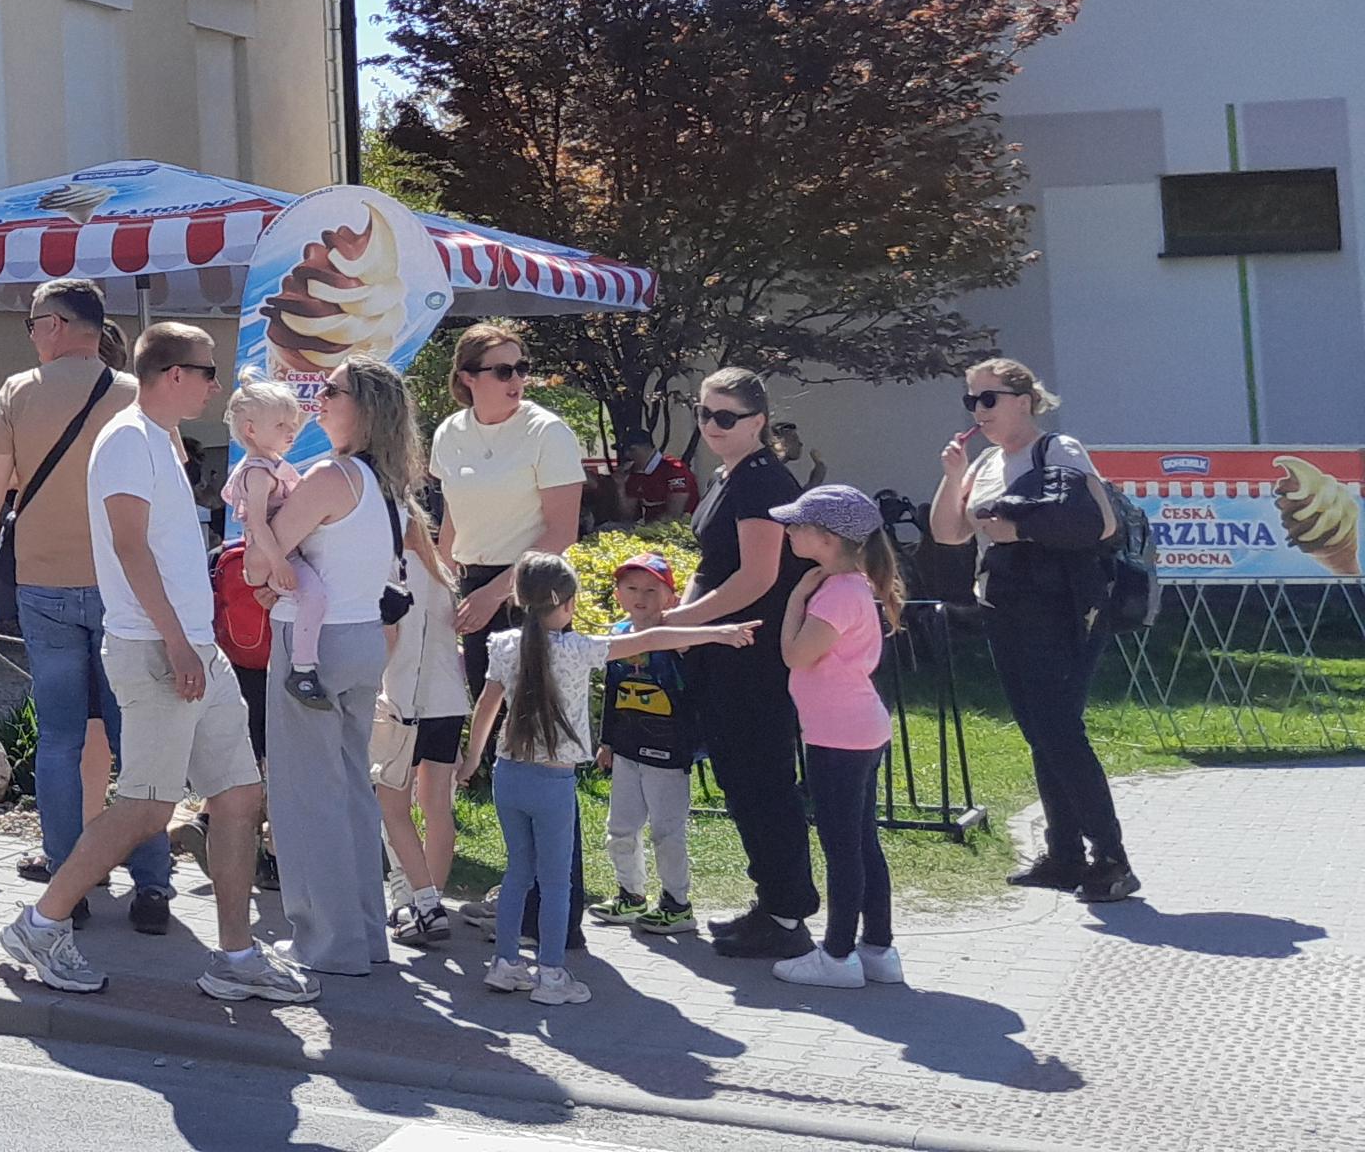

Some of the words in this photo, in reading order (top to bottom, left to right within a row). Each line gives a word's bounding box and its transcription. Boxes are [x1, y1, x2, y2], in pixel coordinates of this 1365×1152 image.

[1162, 503, 1216, 519] ČESKÁ
[1151, 522, 1276, 546] RZLINA
[1166, 550, 1232, 565] OPOČNA
